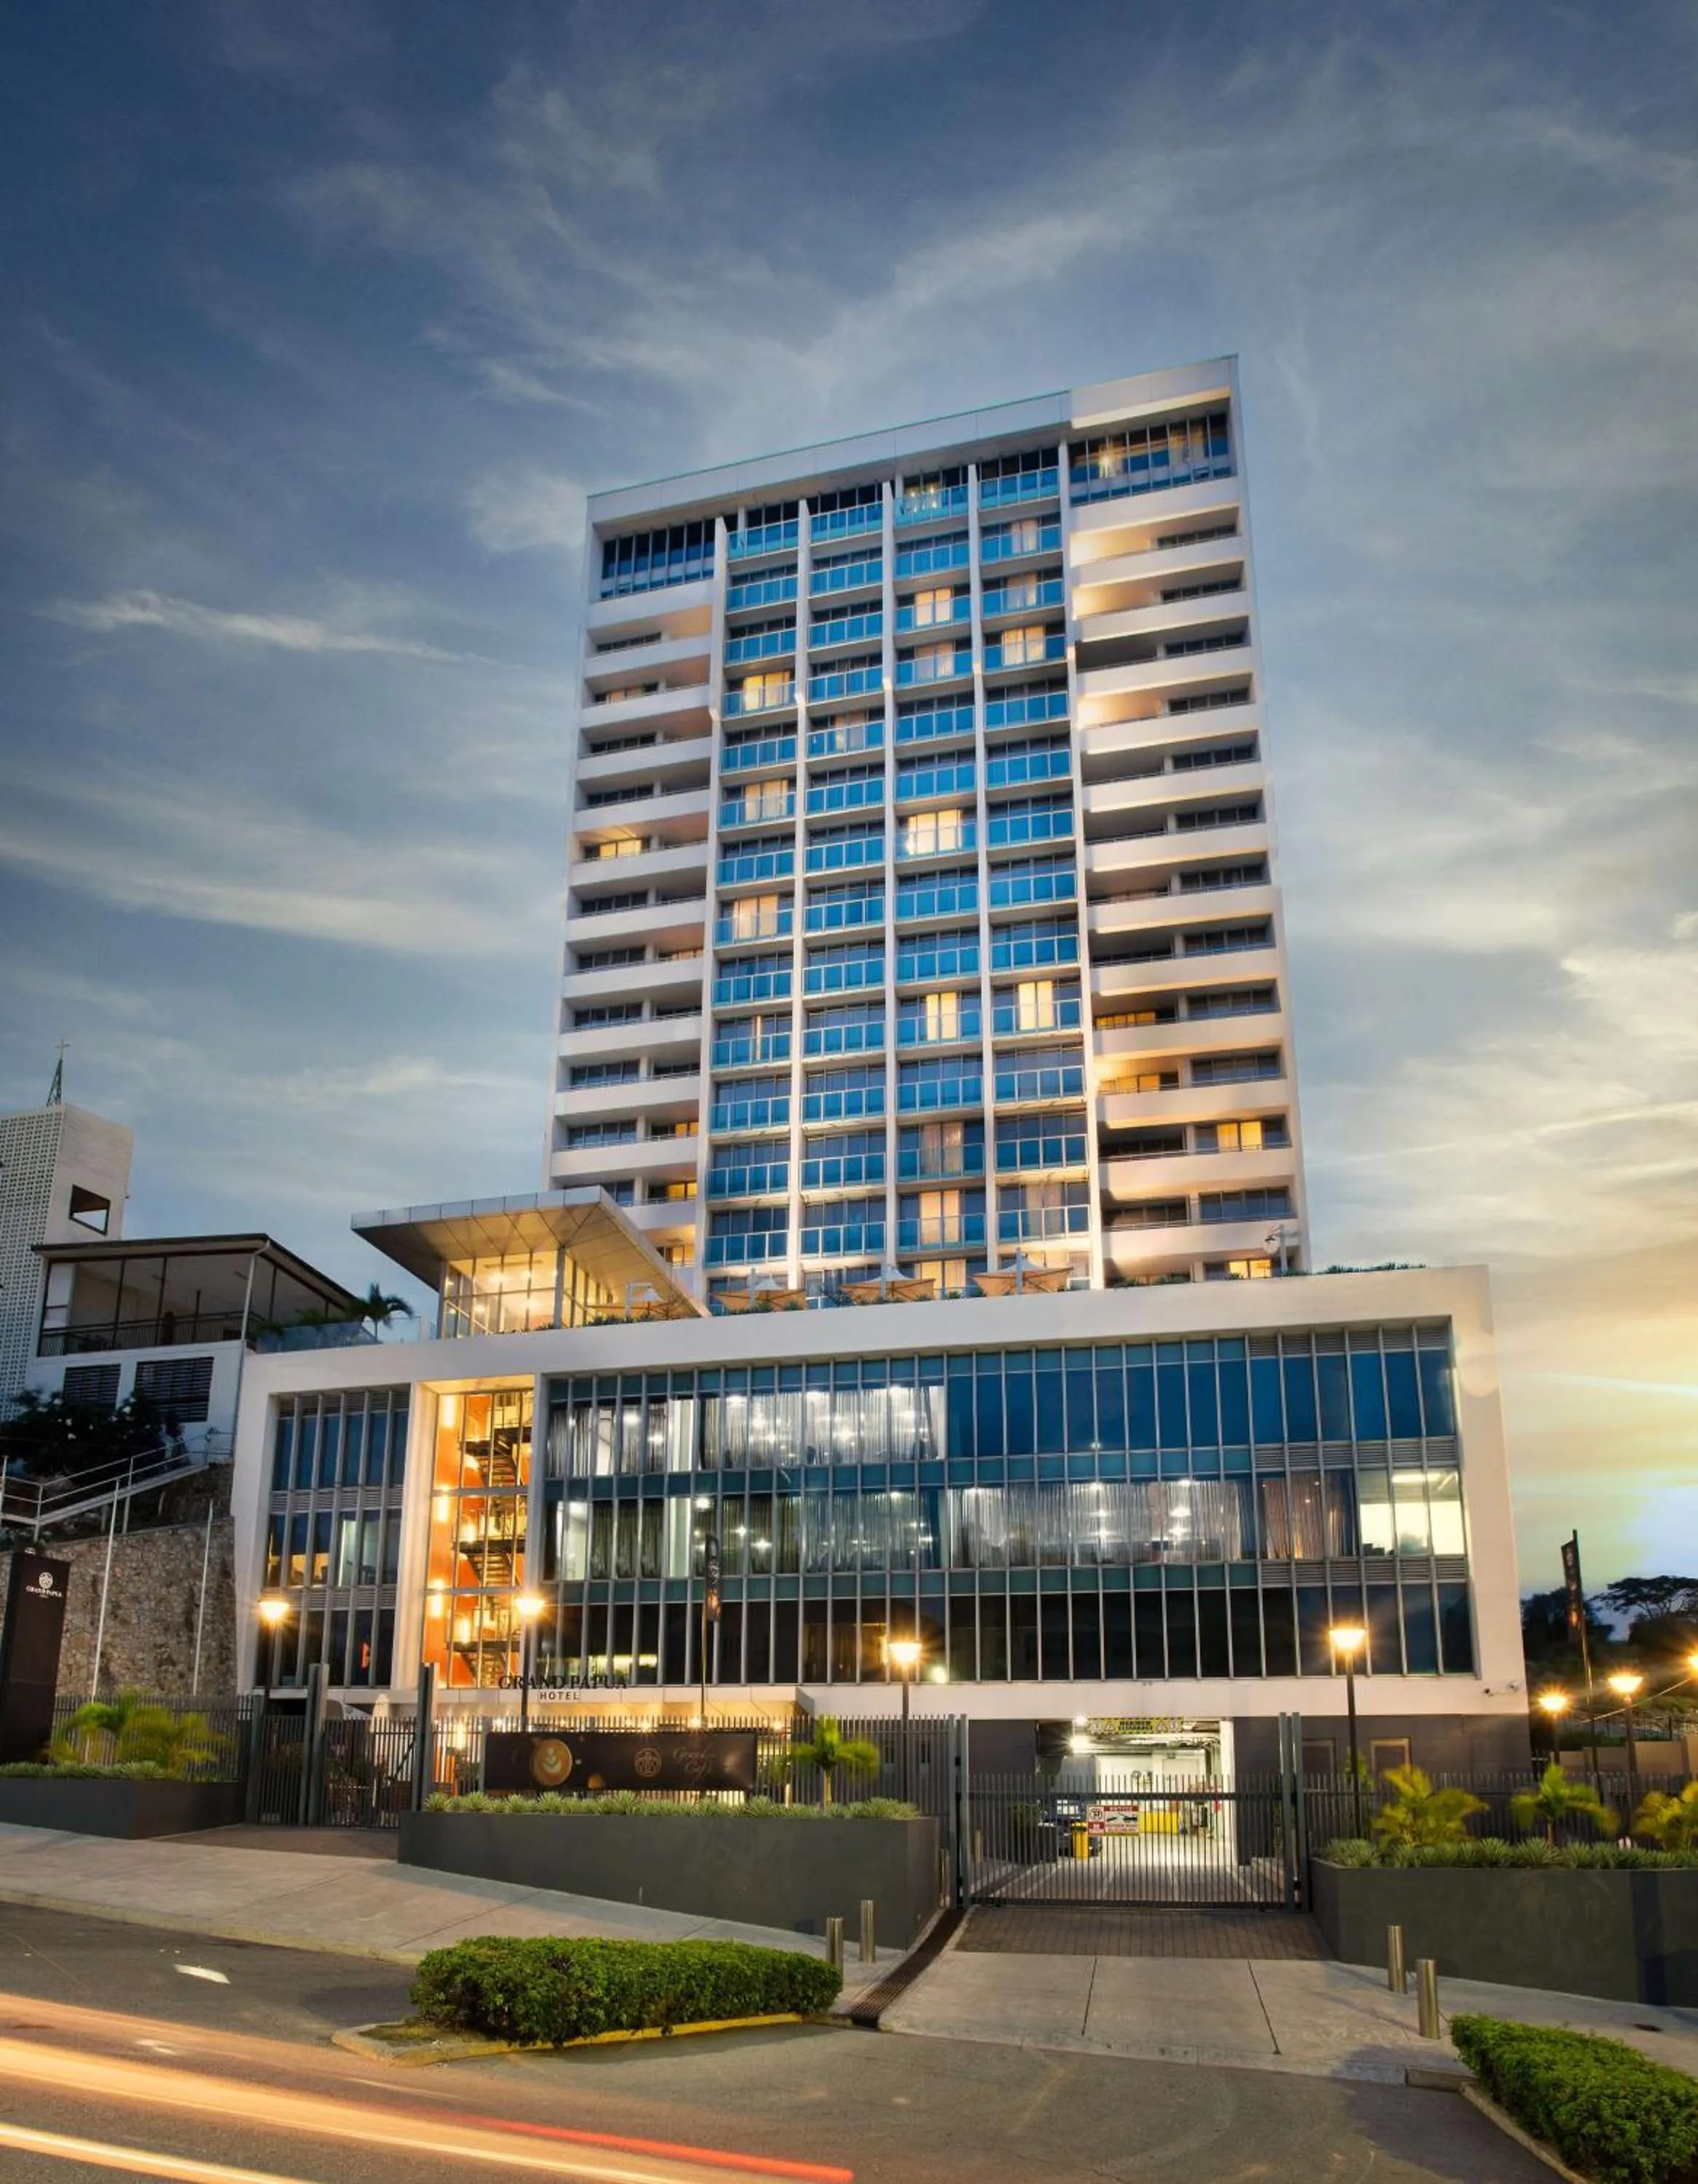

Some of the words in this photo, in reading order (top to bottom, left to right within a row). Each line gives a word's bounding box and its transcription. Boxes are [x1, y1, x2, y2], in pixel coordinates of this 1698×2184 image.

[498, 1675, 566, 1690] GRAND
[570, 1675, 627, 1690] PAPUA
[540, 1691, 580, 1700] HOTEL
